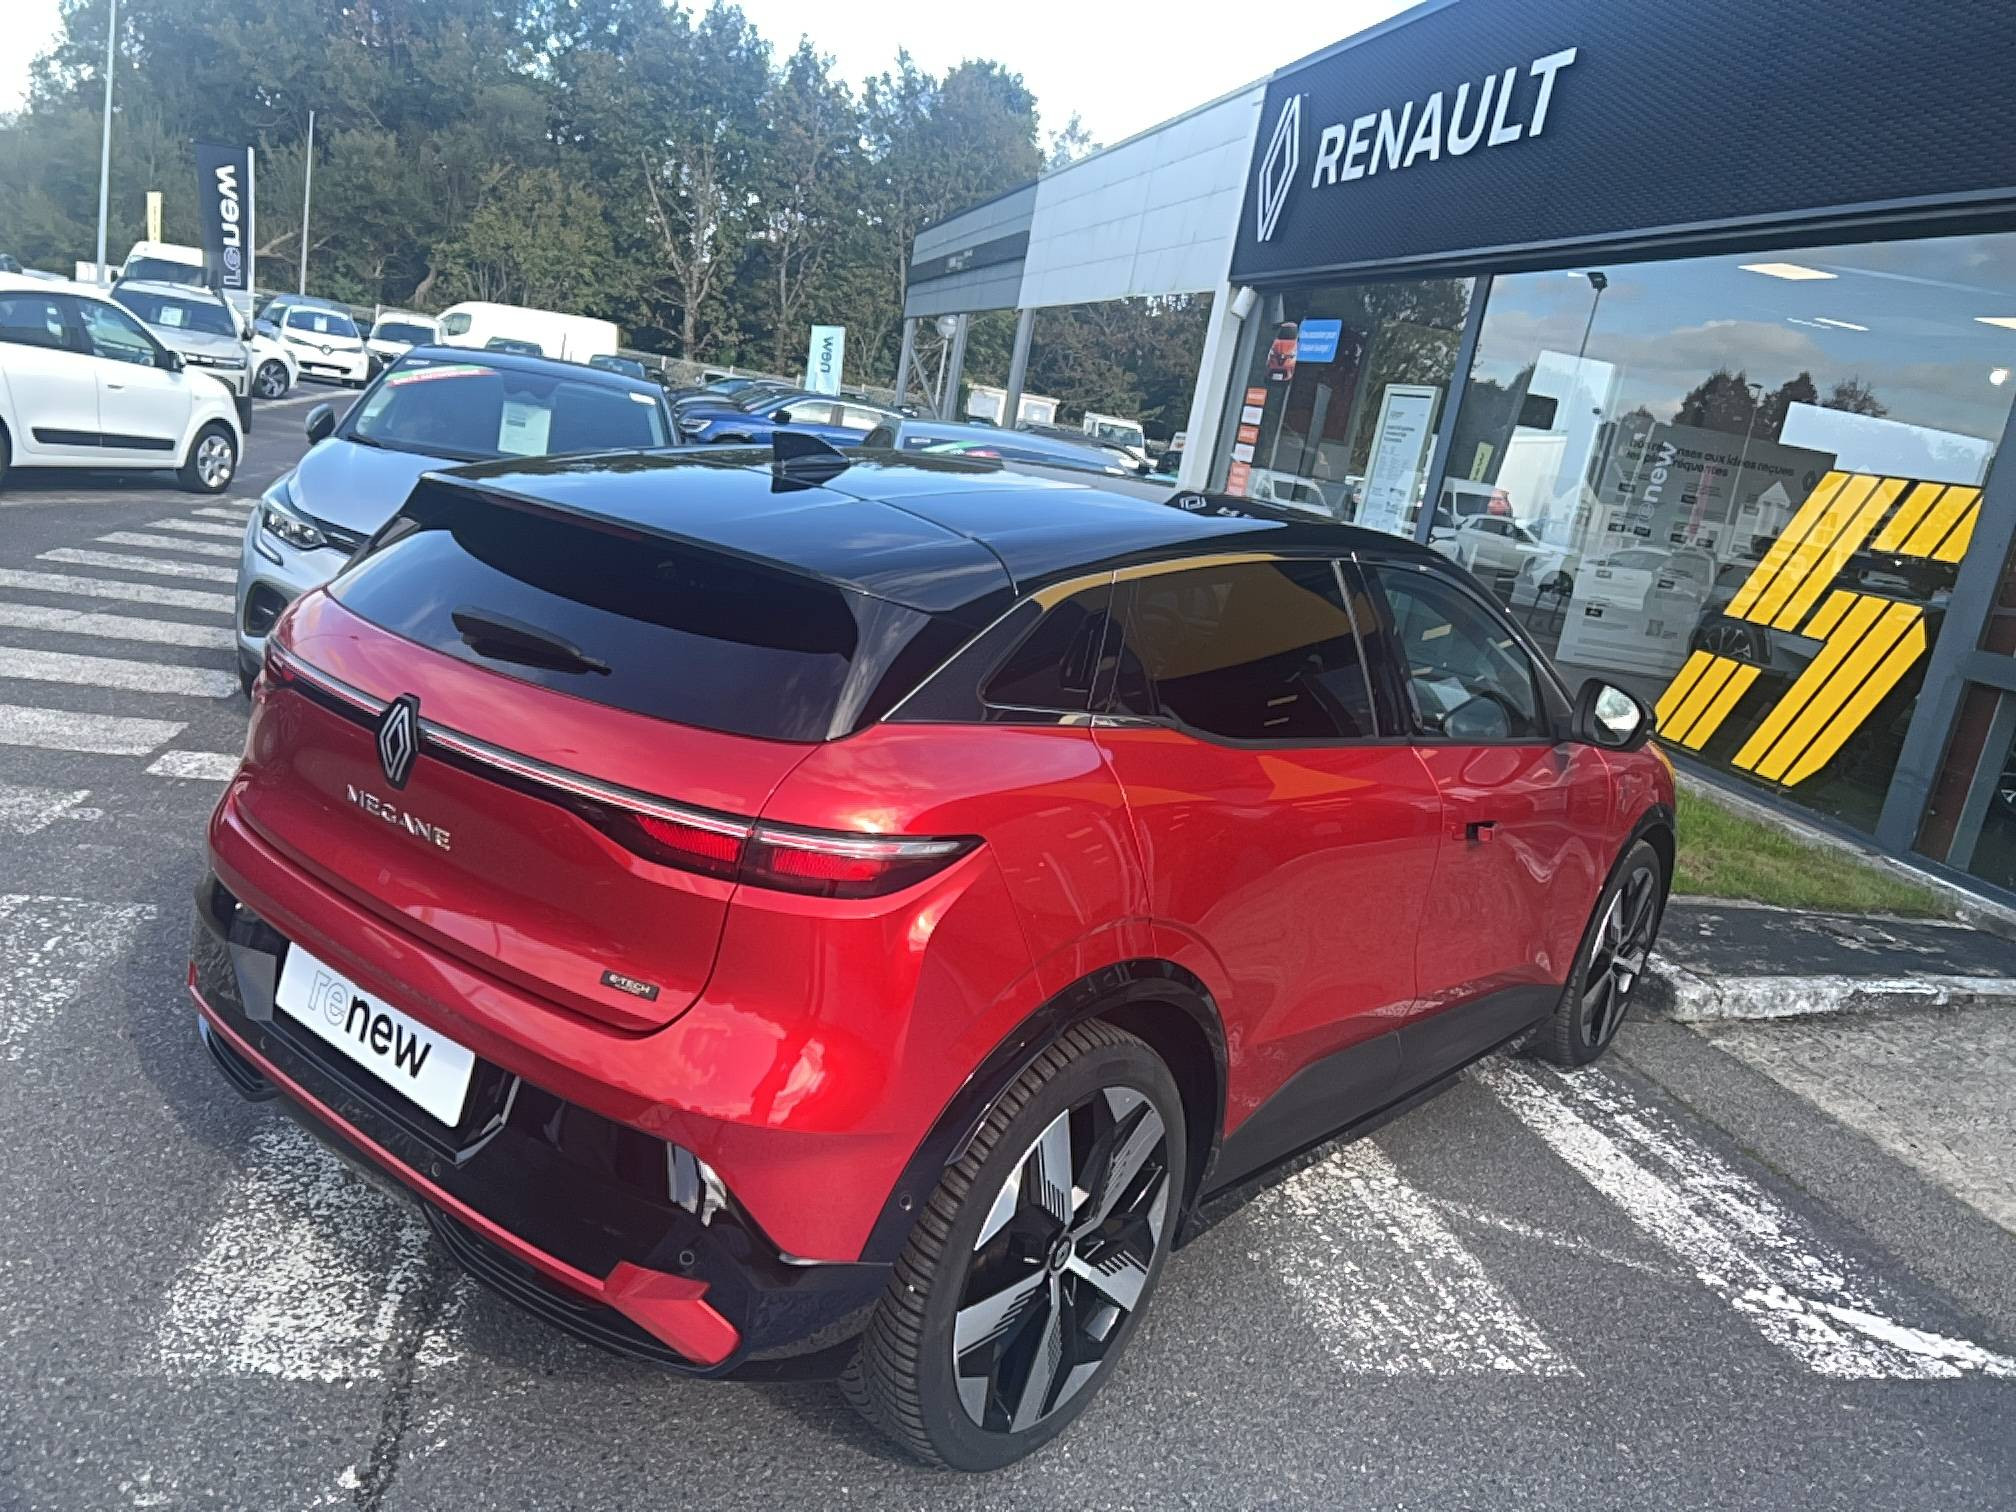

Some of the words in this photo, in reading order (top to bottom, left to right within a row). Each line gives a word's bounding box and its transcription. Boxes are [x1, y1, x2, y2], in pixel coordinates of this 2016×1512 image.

[1311, 46, 1578, 189] RENAULT
[347, 783, 451, 852] MEGANE
[307, 969, 432, 1079] renew
